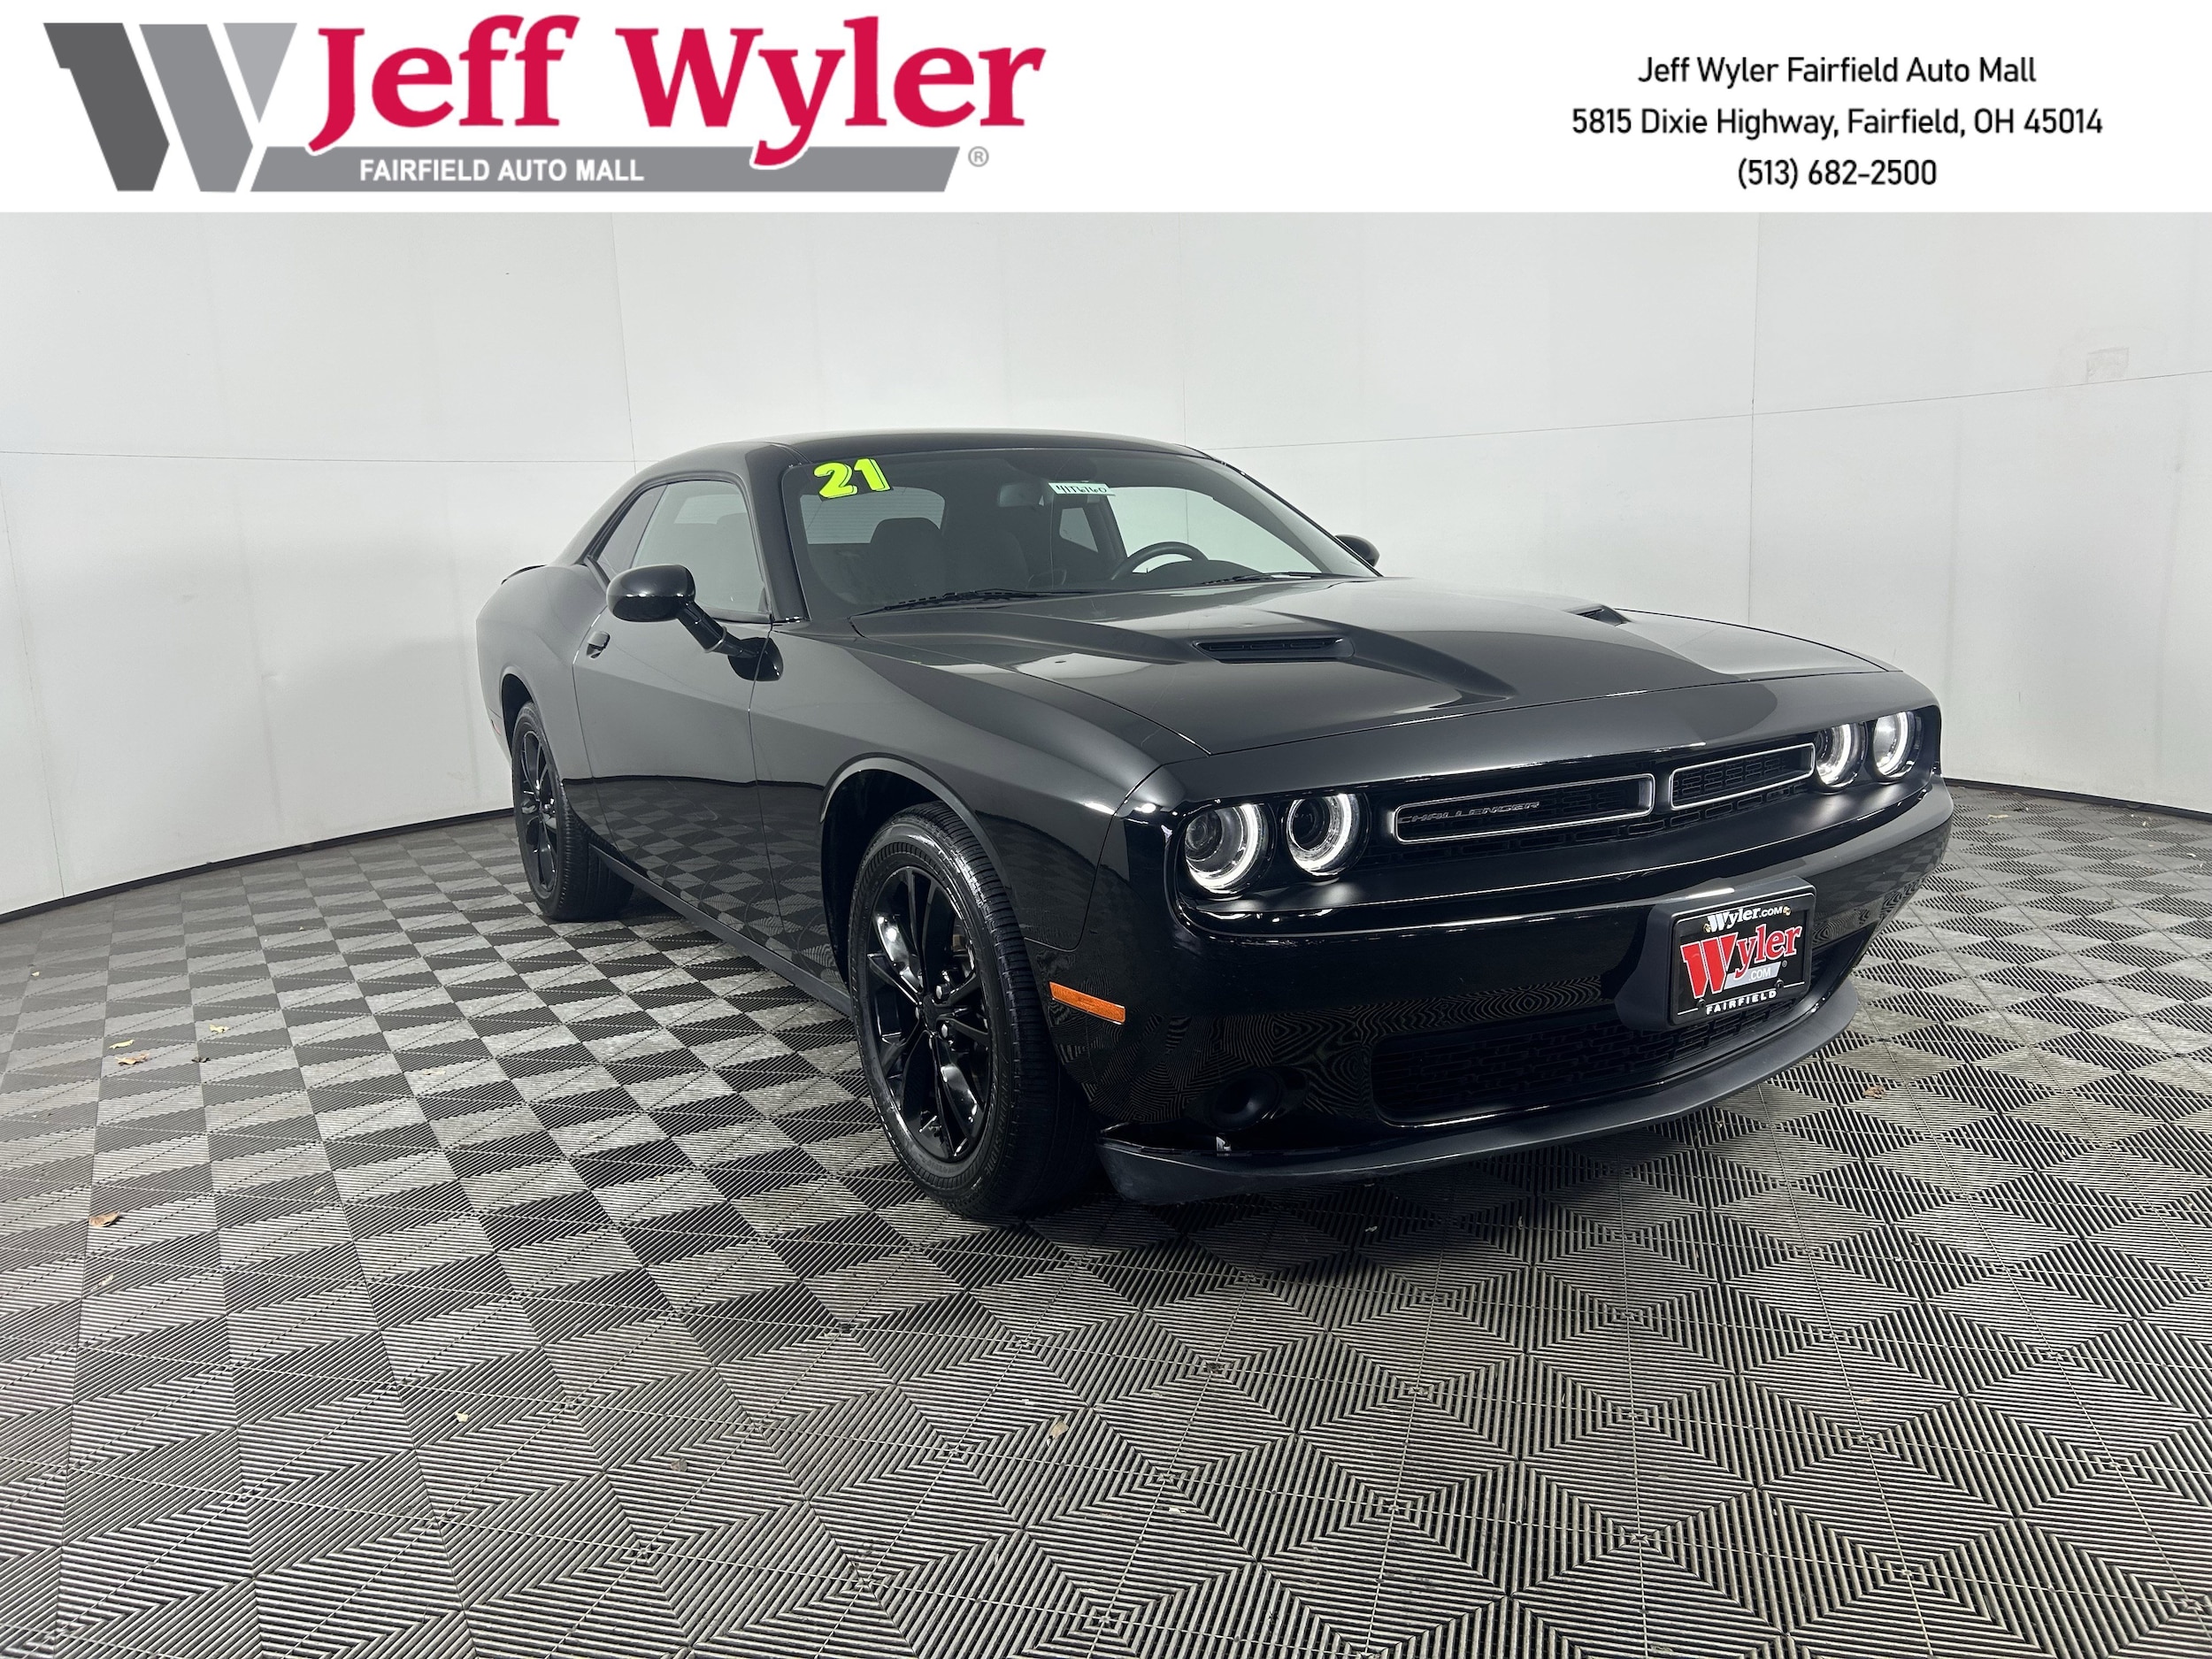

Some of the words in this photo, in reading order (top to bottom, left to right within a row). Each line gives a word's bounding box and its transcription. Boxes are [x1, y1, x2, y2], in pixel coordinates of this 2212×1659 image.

[813, 457, 892, 499] 21
[1398, 801, 1540, 825] CHALLENGER
[1679, 923, 1803, 1000] Wyler
[1706, 990, 1778, 1016] FAIRFIELD
